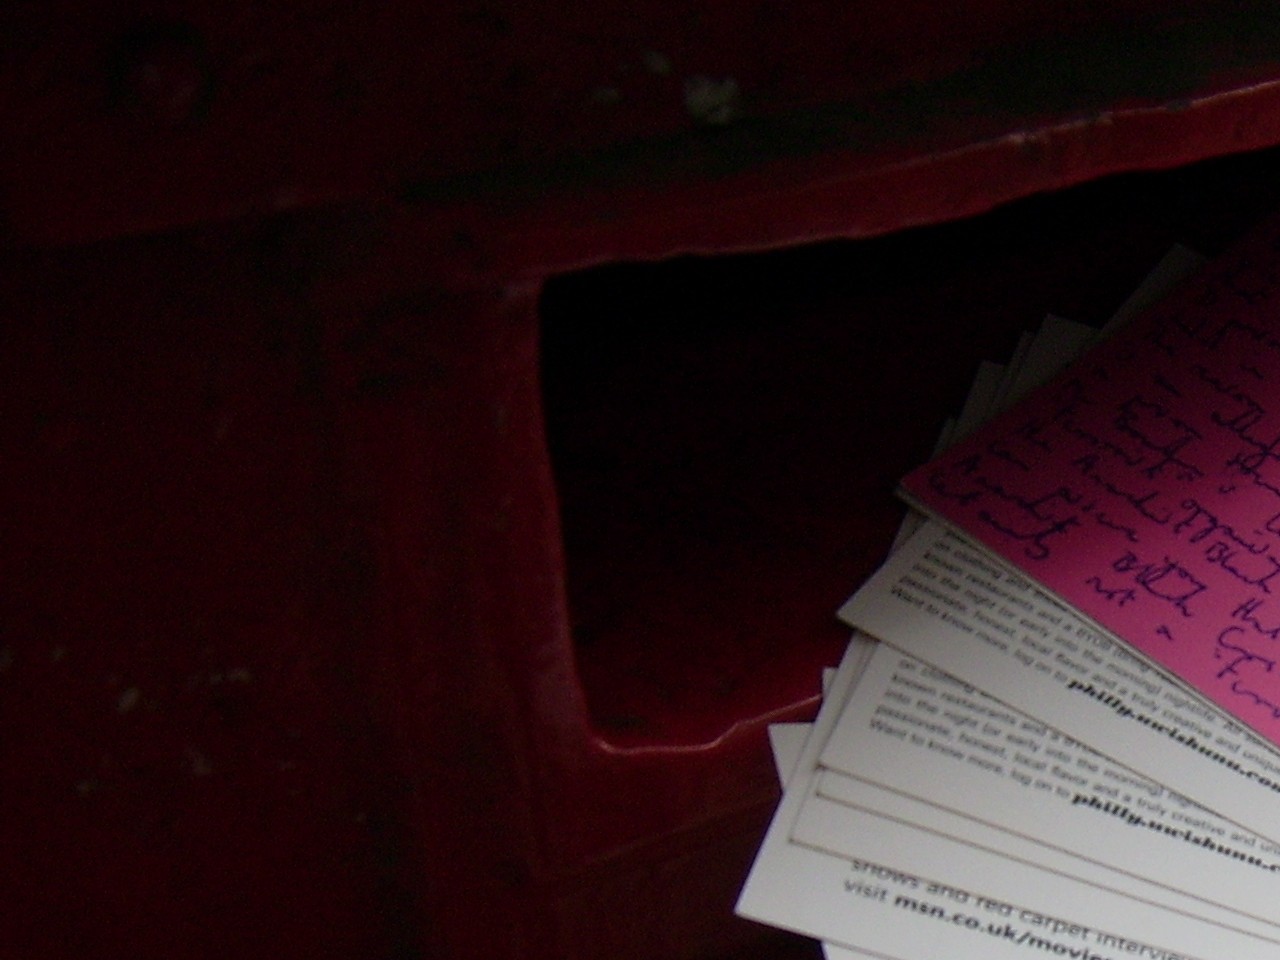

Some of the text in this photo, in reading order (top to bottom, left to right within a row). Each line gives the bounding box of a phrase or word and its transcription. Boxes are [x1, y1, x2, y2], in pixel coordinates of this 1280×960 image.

[1090, 671, 1117, 691] and
[1214, 733, 1241, 753] and
[1075, 757, 1099, 773] the
[1091, 780, 1119, 798] and
[1170, 808, 1227, 837] creative
[1229, 829, 1256, 847] and
[843, 876, 887, 901] visit
[1018, 907, 1091, 942] carpet
